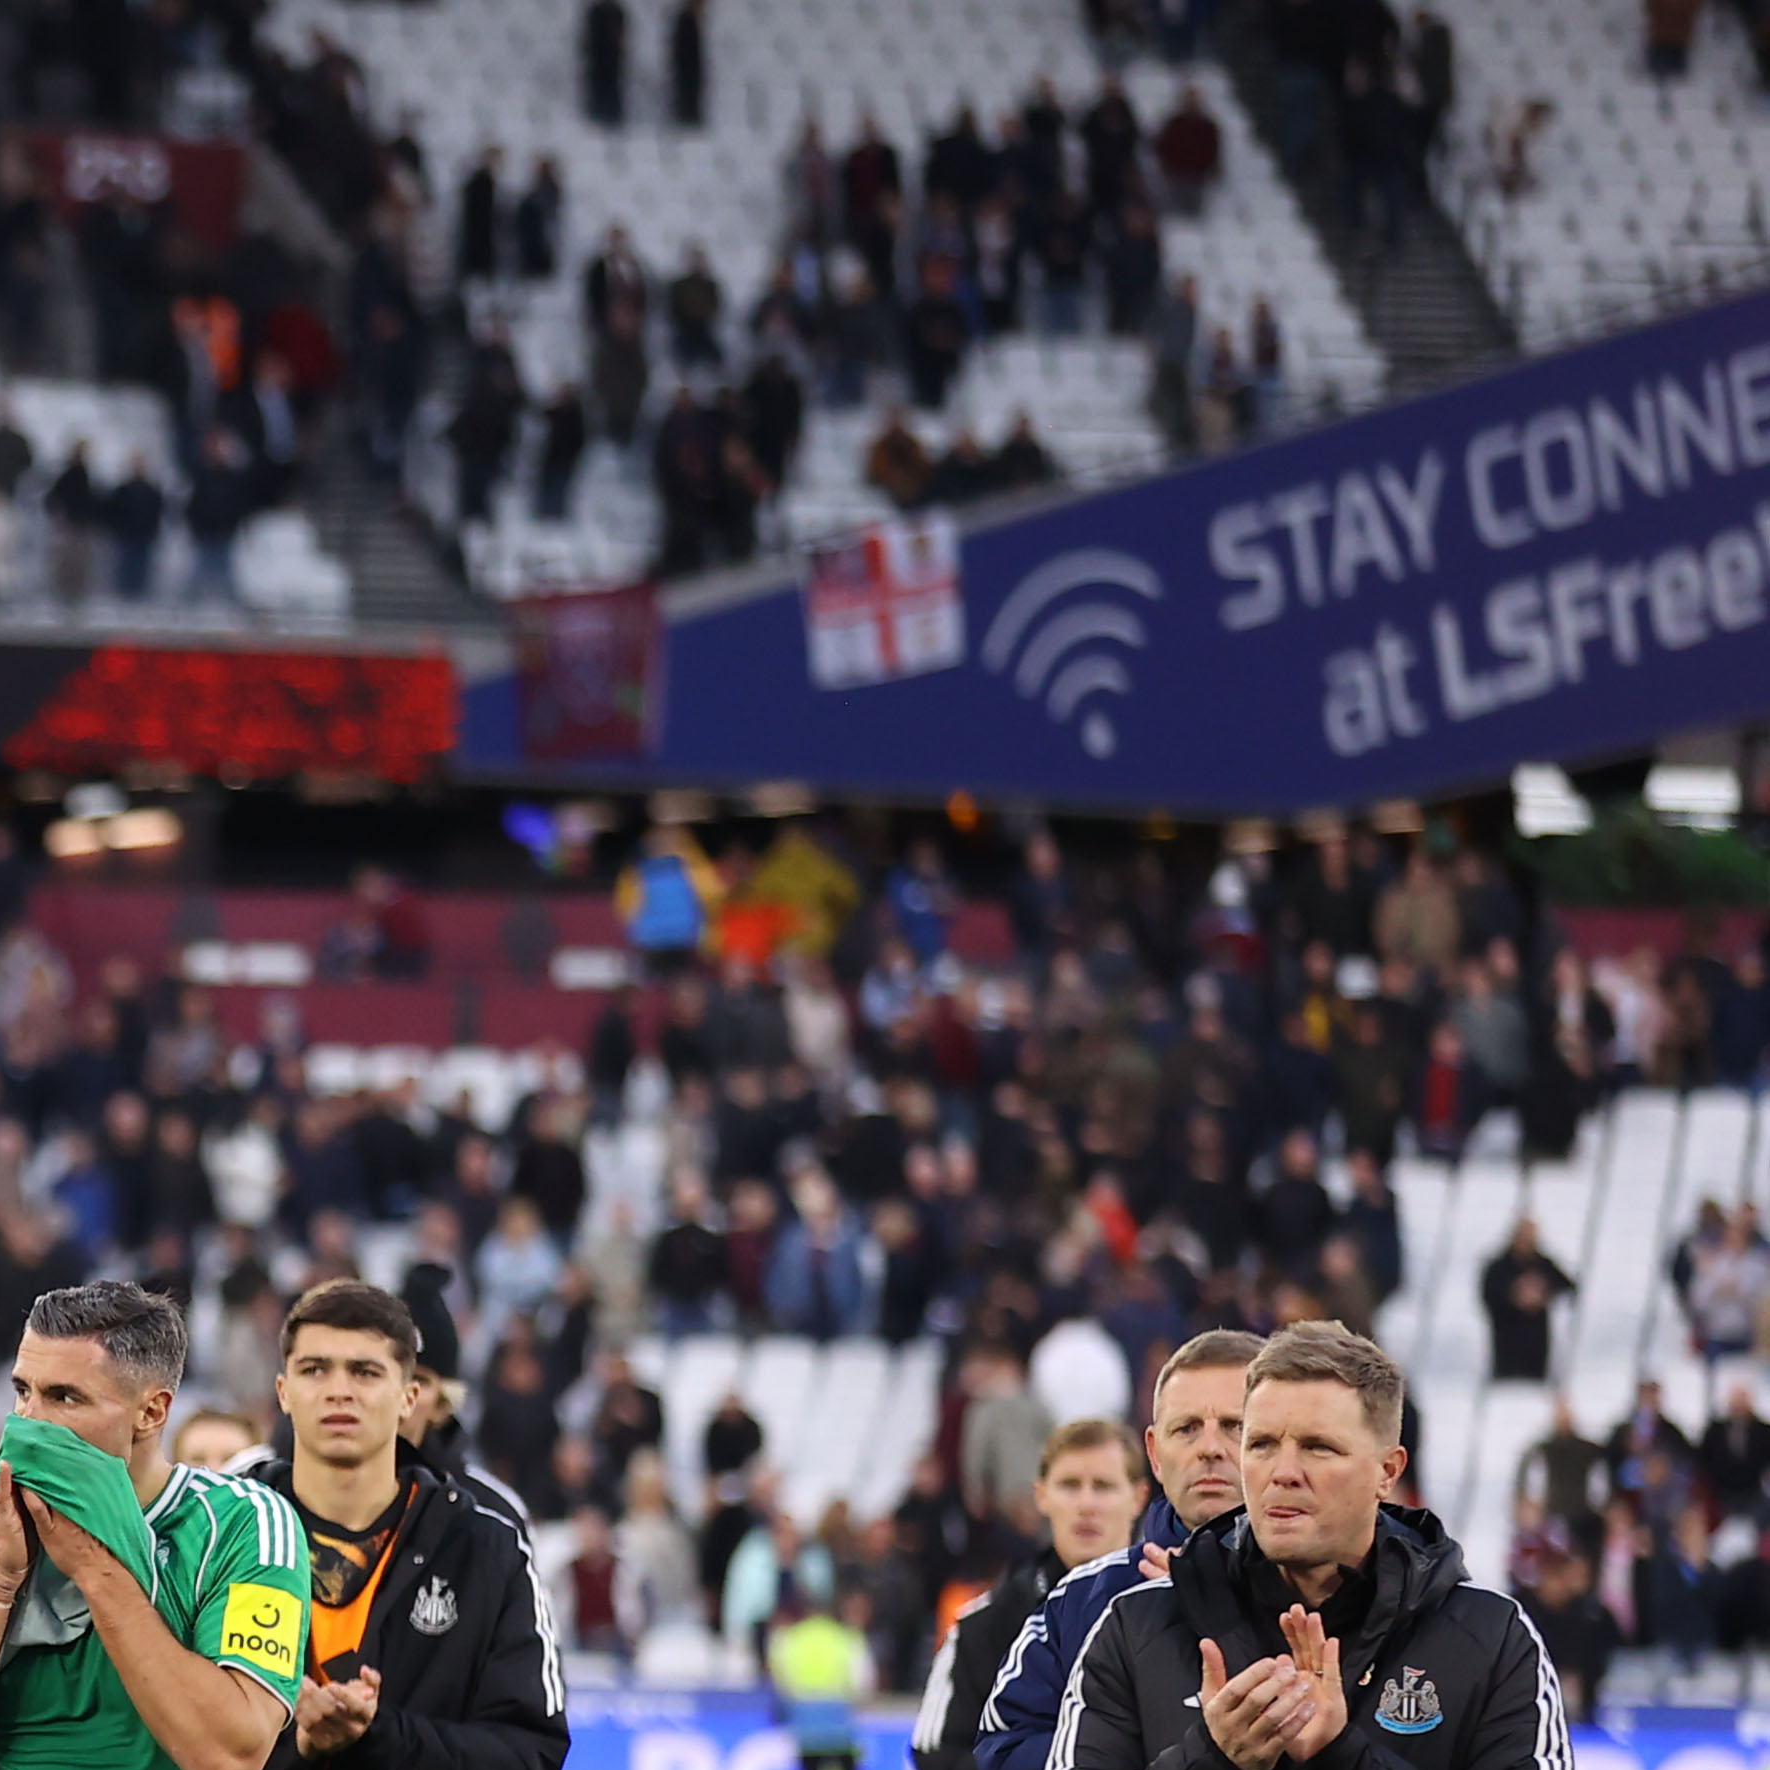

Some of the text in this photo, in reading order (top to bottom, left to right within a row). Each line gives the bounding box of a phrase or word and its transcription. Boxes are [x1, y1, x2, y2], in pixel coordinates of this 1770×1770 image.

[1208, 447, 1445, 632] STAY
[1322, 500, 1770, 758] at LSFree
[228, 1632, 291, 1664] noon
